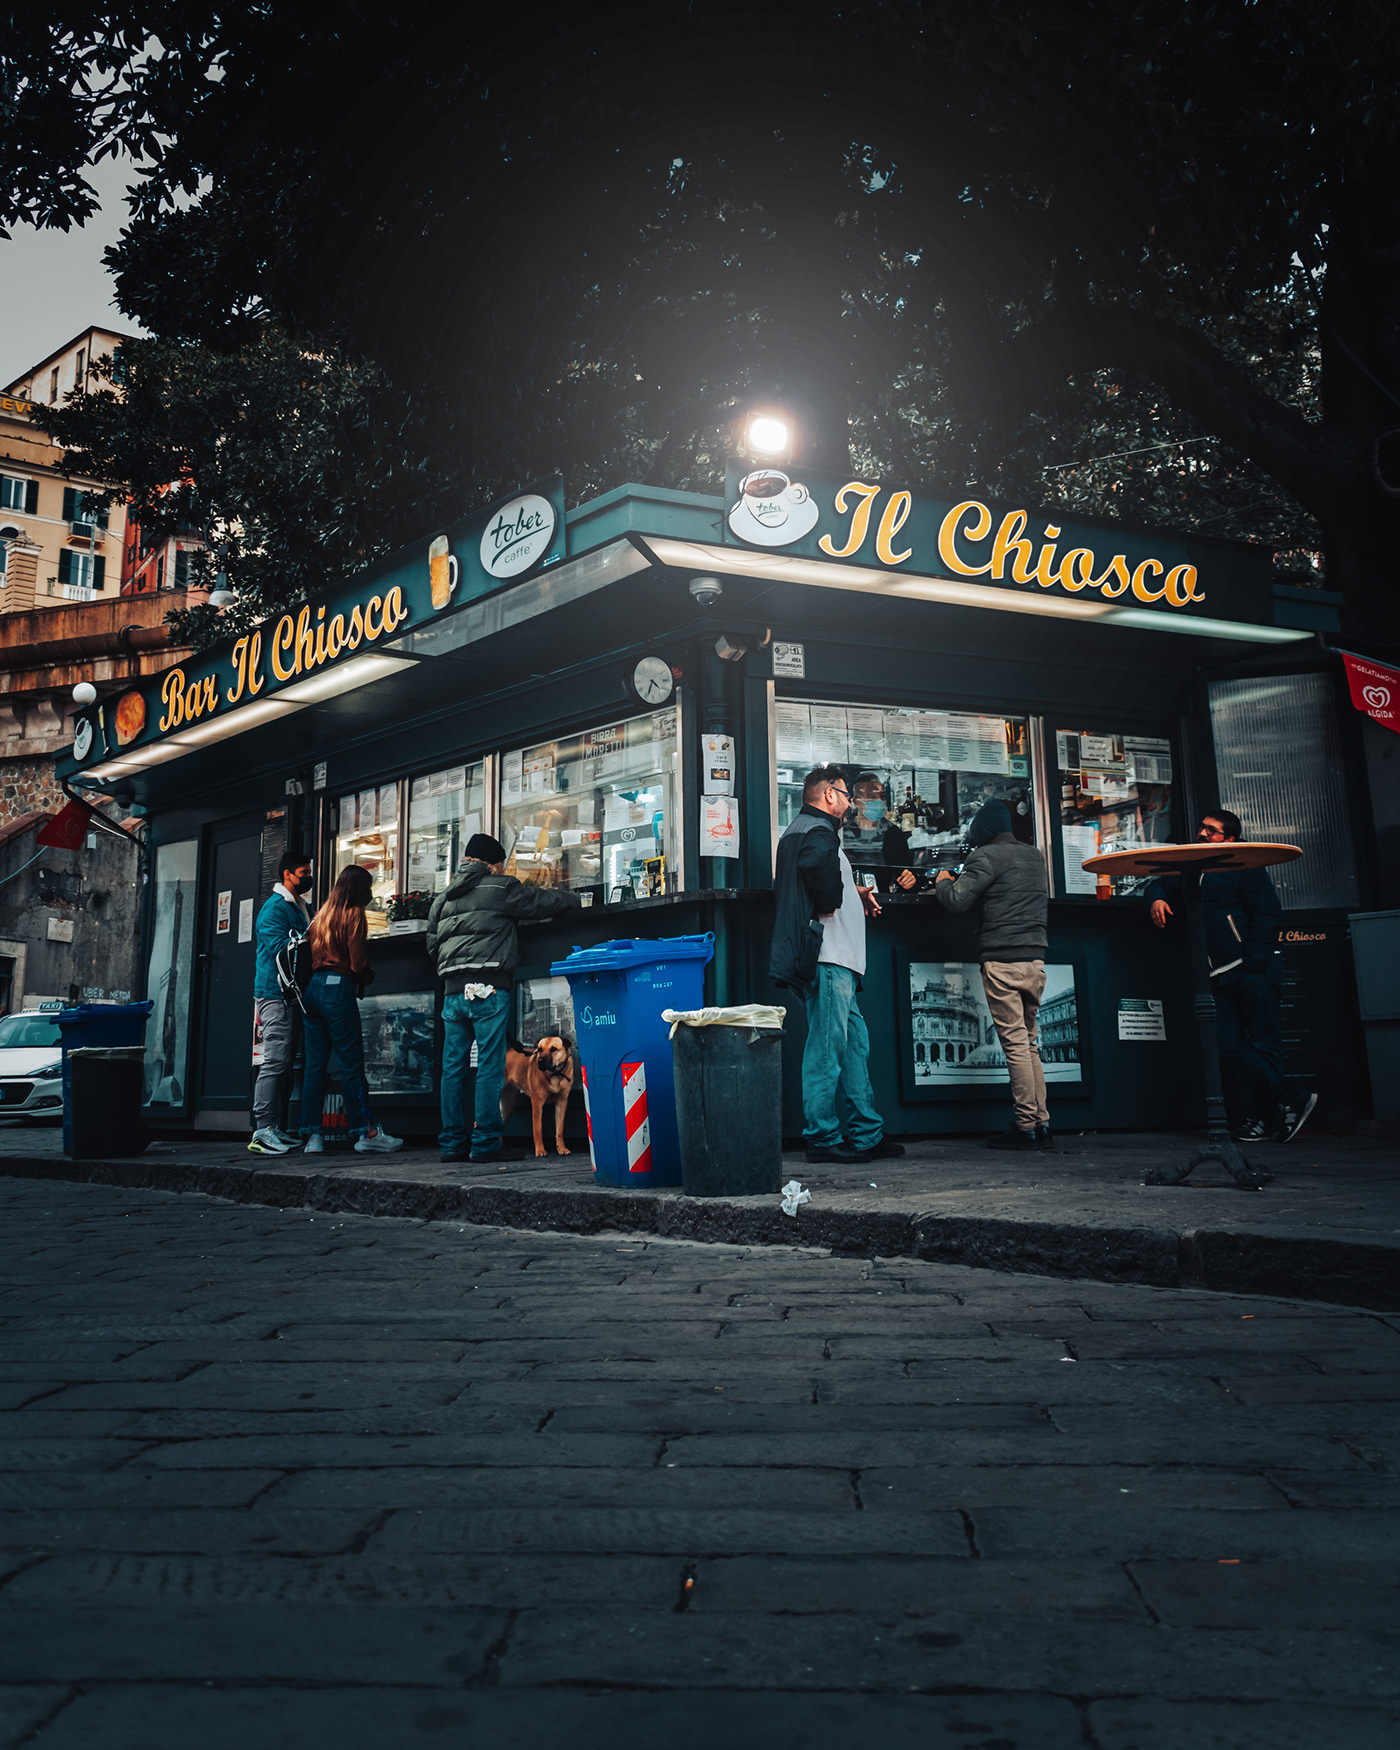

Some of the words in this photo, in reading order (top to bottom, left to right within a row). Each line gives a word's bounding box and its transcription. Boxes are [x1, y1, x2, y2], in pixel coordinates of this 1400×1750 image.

[756, 502, 782, 512] tober
[490, 506, 544, 549] tober
[818, 480, 912, 565] Il
[938, 500, 1206, 607] Chiosco
[158, 668, 219, 732] Bar
[227, 630, 265, 704] Il
[271, 585, 409, 682] Chiosco
[1367, 709, 1394, 719] ALGIDA
[590, 727, 617, 745] BIRRA
[584, 739, 623, 760] MORETTI
[1285, 930, 1327, 942] Chiosco
[82, 987, 104, 999] UBER
[594, 1010, 617, 1026] amiu
